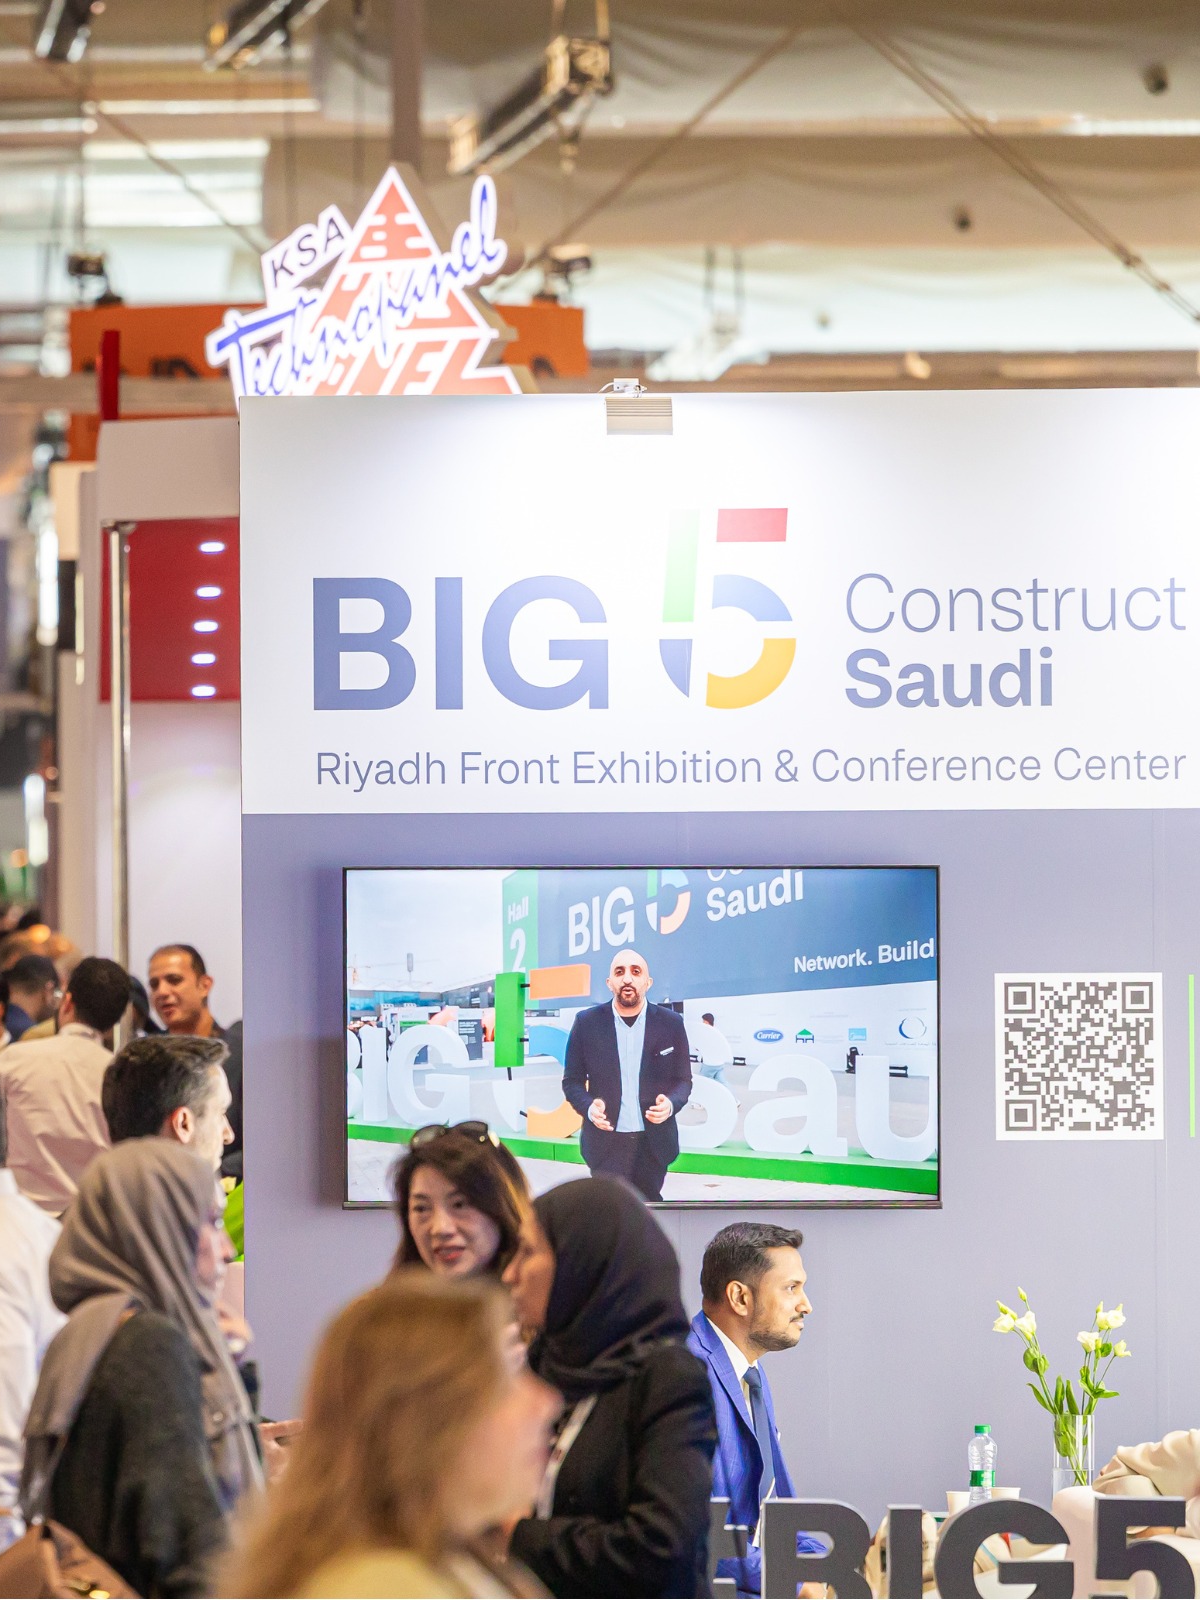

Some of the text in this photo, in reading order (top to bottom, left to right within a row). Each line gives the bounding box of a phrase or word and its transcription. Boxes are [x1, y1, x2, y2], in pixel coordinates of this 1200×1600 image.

[271, 217, 344, 288] KSA
[313, 508, 797, 711] BIG 5
[846, 573, 1187, 633] Construct
[845, 646, 1053, 708] Saudi
[316, 747, 1186, 792] Riyadh Front Exhibition & Conference Center
[508, 896, 529, 924] Hall
[568, 886, 635, 957] BIG
[707, 869, 803, 922] Saudi
[510, 928, 526, 973] 2
[794, 938, 935, 973] Network. Build
[755, 1030, 782, 1042] Carrier
